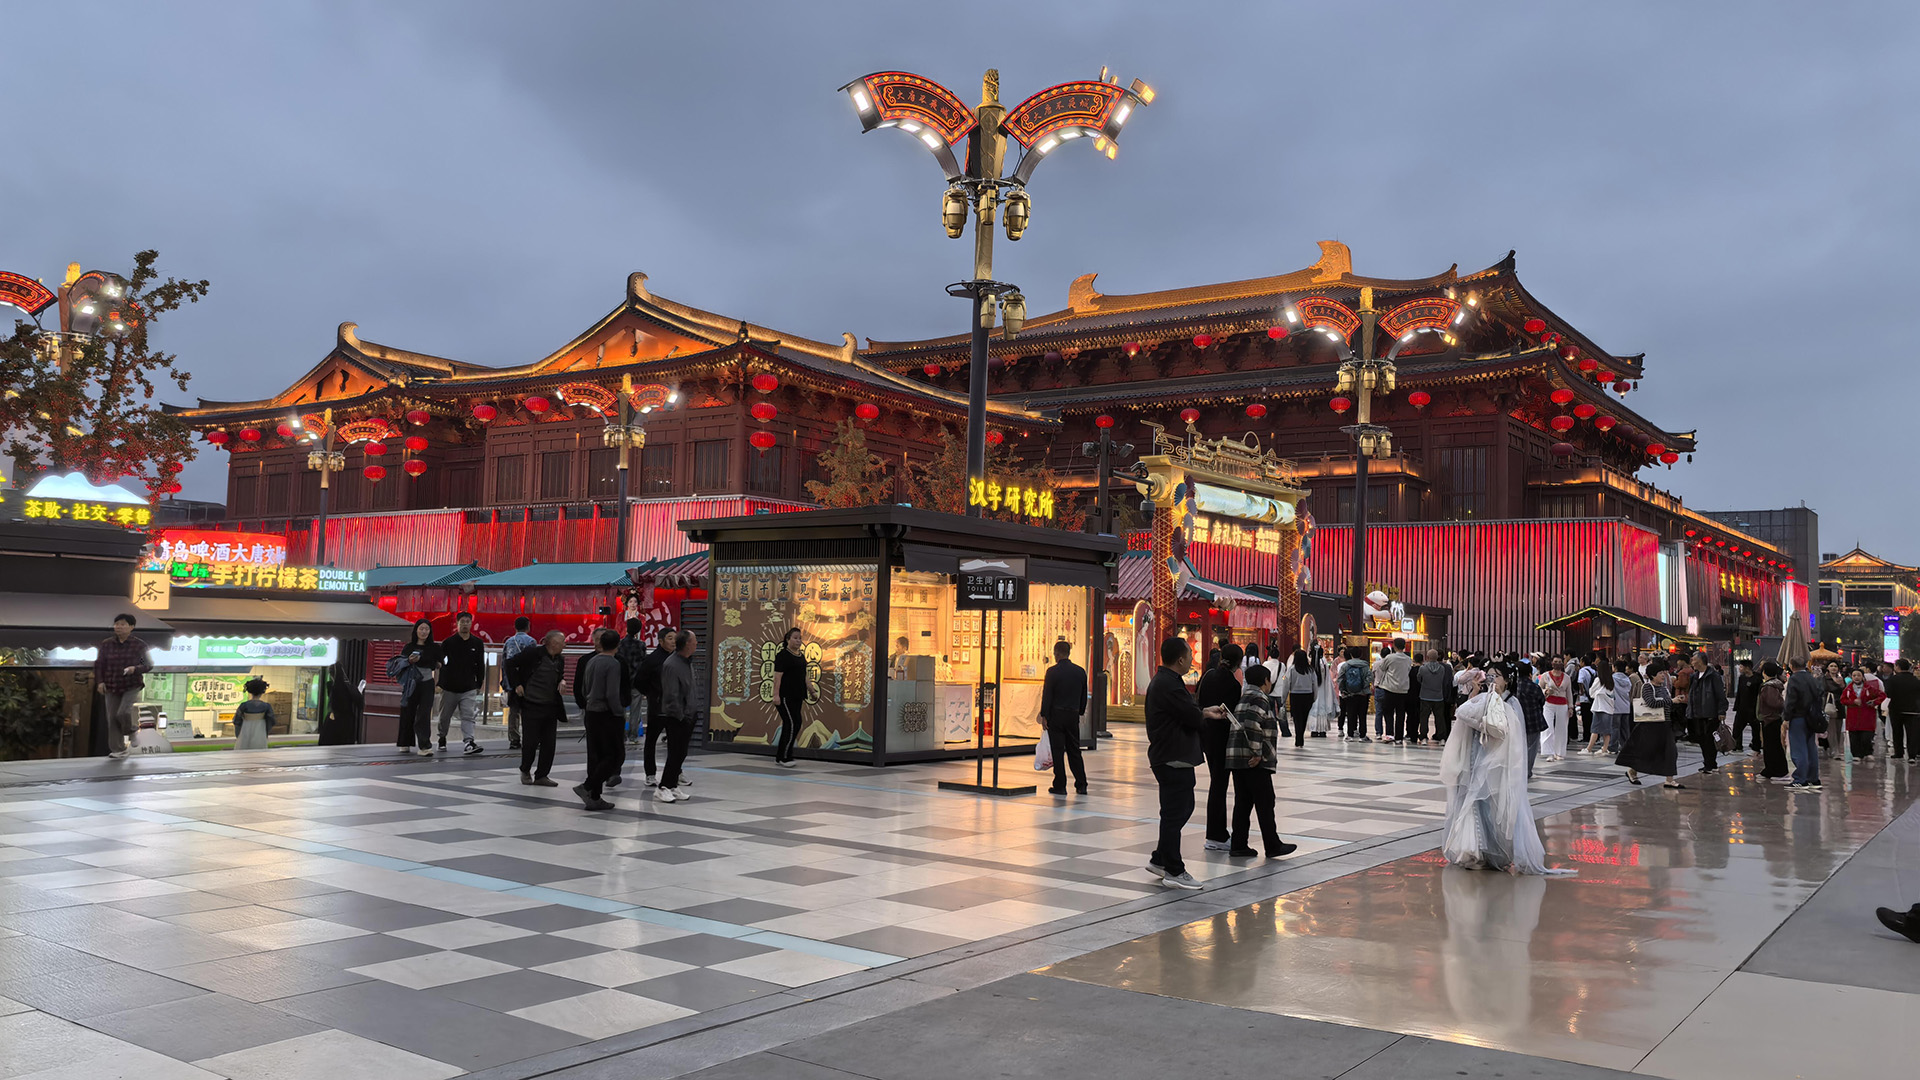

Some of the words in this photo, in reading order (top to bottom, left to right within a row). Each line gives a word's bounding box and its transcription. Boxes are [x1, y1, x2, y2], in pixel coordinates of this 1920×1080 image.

[896, 89, 950, 120] 大唐不夜城
[1032, 96, 1091, 123] 大唐不夜城
[968, 477, 1054, 520] 汉字研究所
[211, 564, 319, 590] 手打柠檬茶
[318, 580, 348, 591] LEMON
[349, 582, 366, 592] TEA
[319, 569, 354, 580] DOUBLE
[966, 576, 994, 585] 卫生间
[138, 580, 165, 602] 茶
